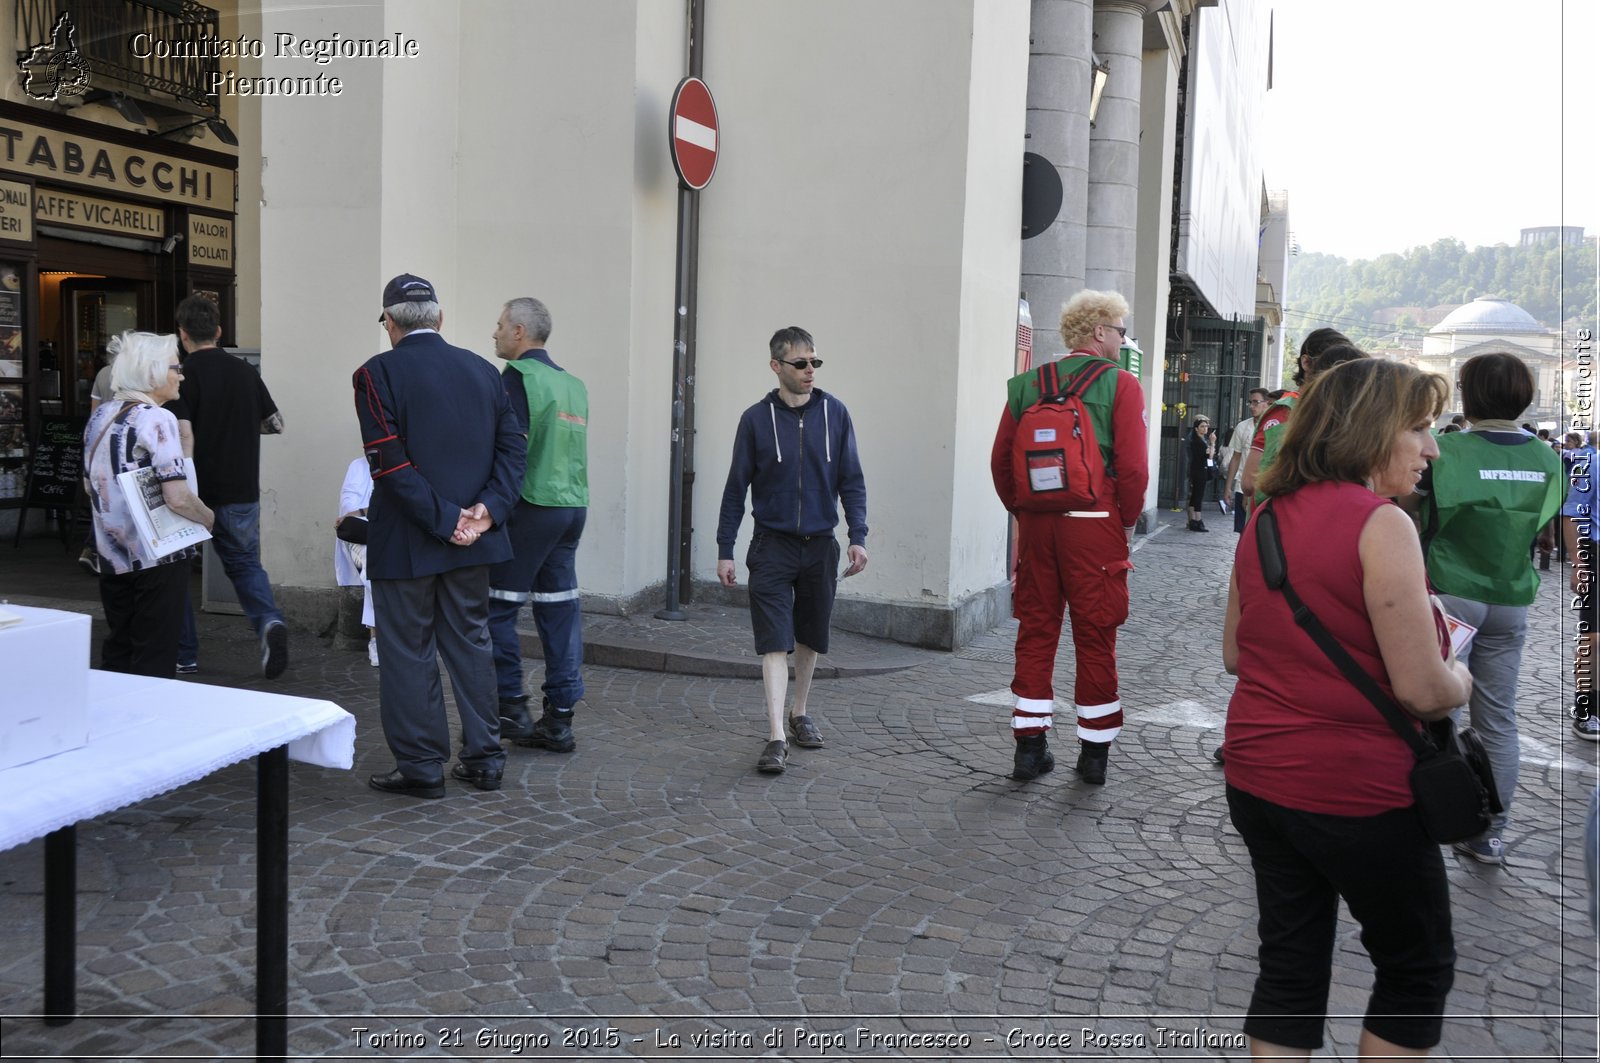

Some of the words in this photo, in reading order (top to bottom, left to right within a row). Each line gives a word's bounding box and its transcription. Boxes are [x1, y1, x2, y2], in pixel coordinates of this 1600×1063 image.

[0, 127, 213, 200] TABACCHI
[83, 202, 161, 233] VICARELLI
[193, 221, 228, 239] VALORI
[192, 245, 229, 261] BOLLATI
